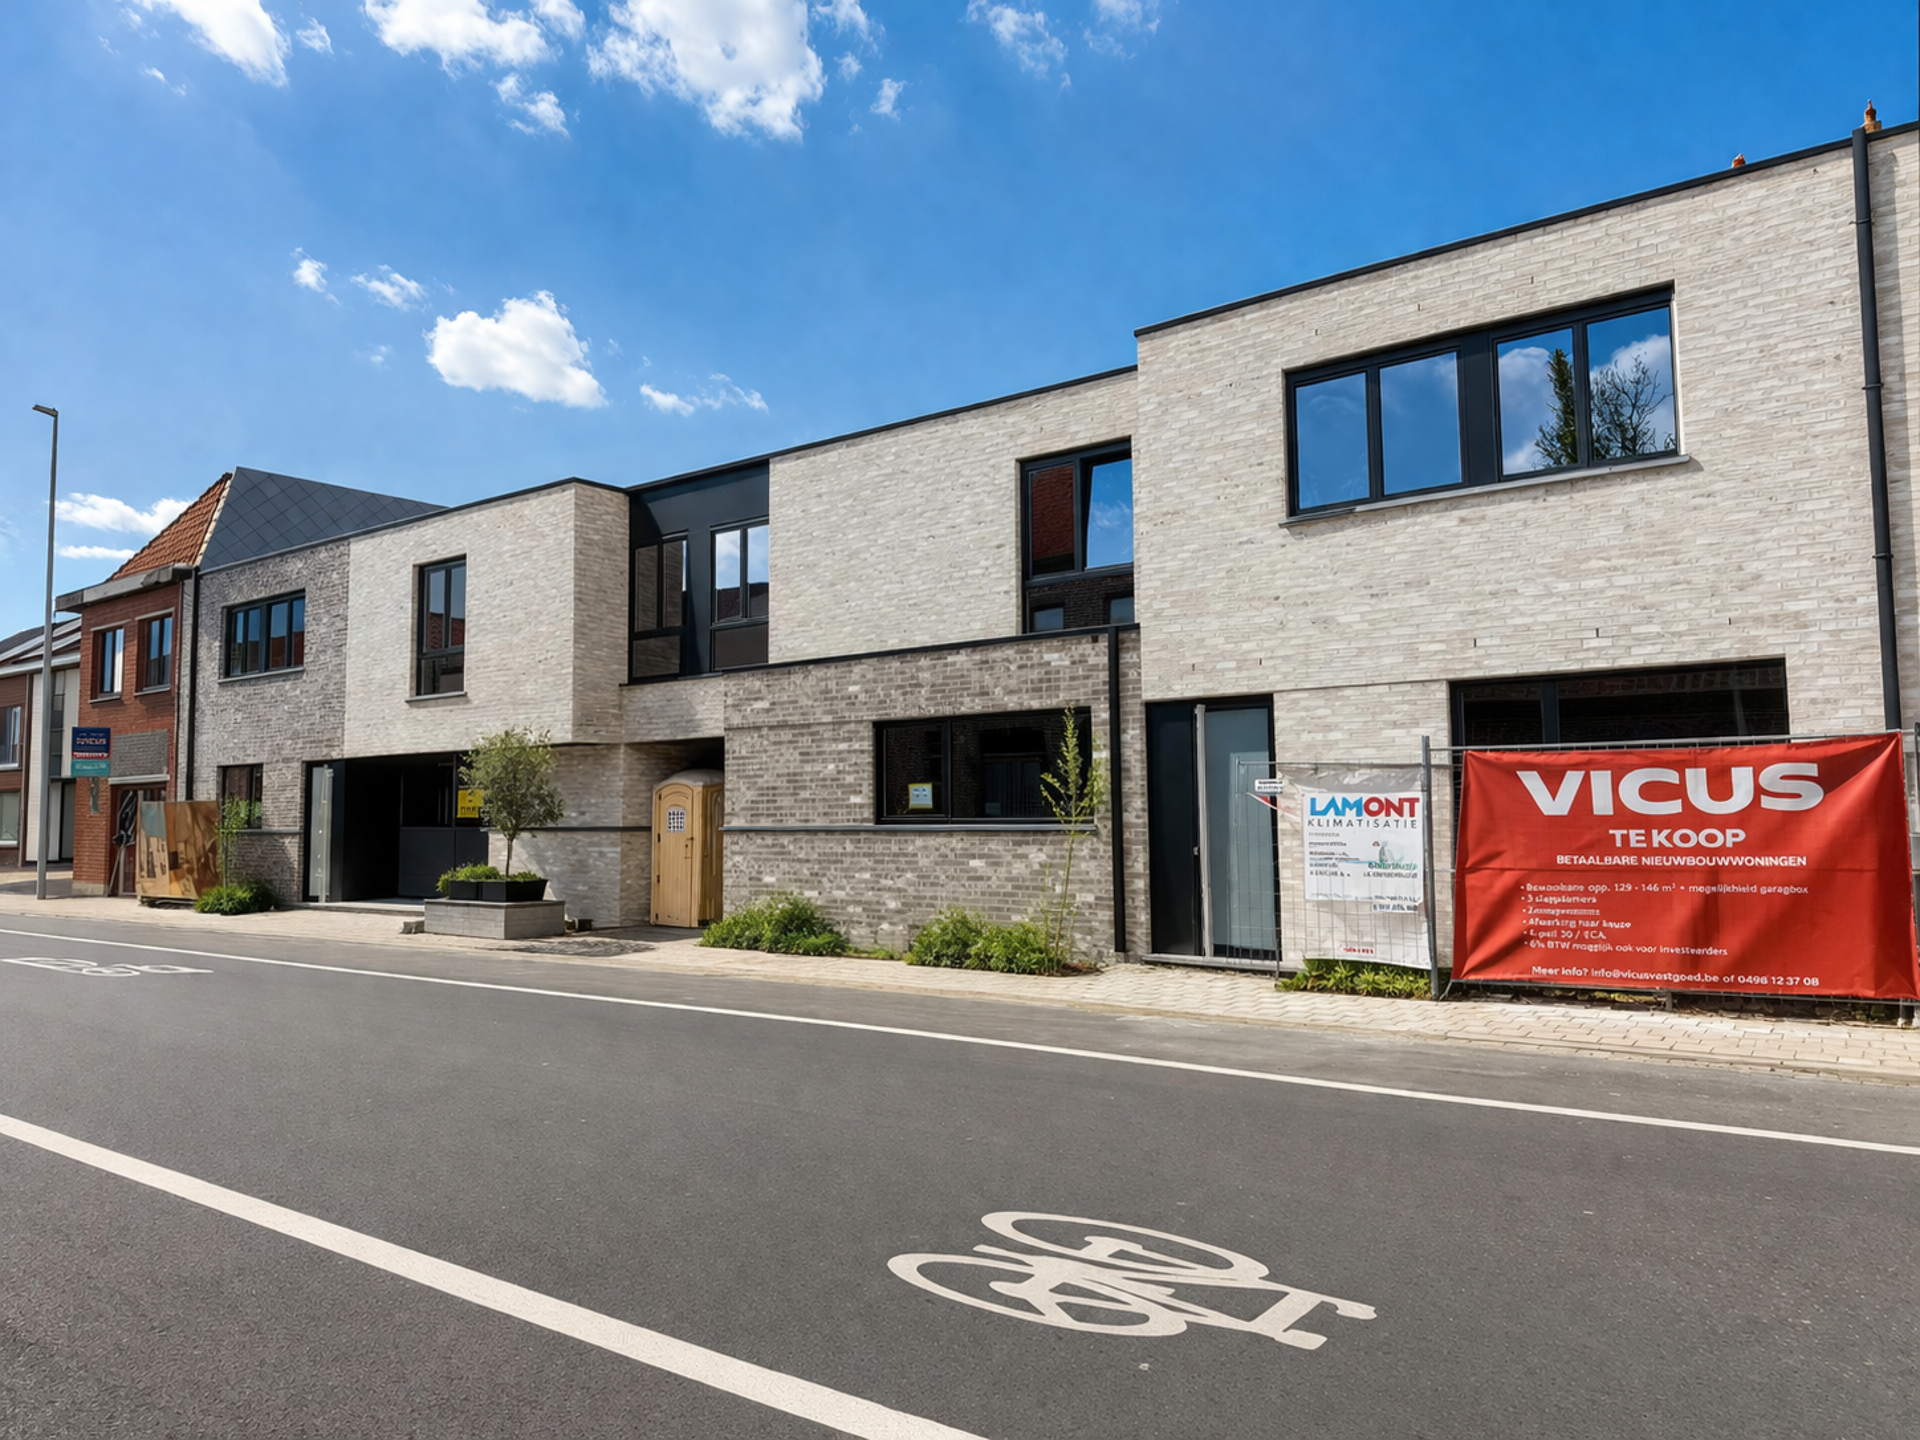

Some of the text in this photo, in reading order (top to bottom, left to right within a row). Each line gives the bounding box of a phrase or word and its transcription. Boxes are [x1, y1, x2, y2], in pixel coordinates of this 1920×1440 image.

[1516, 762, 1825, 816] VICUS
[1309, 795, 1420, 818] LAMONT
[1307, 818, 1418, 829] KLIMATISATIE
[1608, 828, 1747, 849] TE KOOP
[1556, 854, 1807, 867] BETAALBARE NIEUWBOUWWONINGEN
[1588, 884, 1611, 894] opp.
[1614, 883, 1632, 892] 129
[1641, 883, 1660, 892] 146
[1547, 941, 1571, 950] BTW
[1615, 943, 1633, 953] ook
[1635, 945, 1657, 953] voor
[1531, 966, 1560, 976] Meer
[1722, 974, 1735, 983] of
[1737, 975, 1769, 985] 0498
[1770, 976, 1784, 986] 12
[1785, 976, 1801, 987] 37
[1802, 976, 1820, 987] 08
